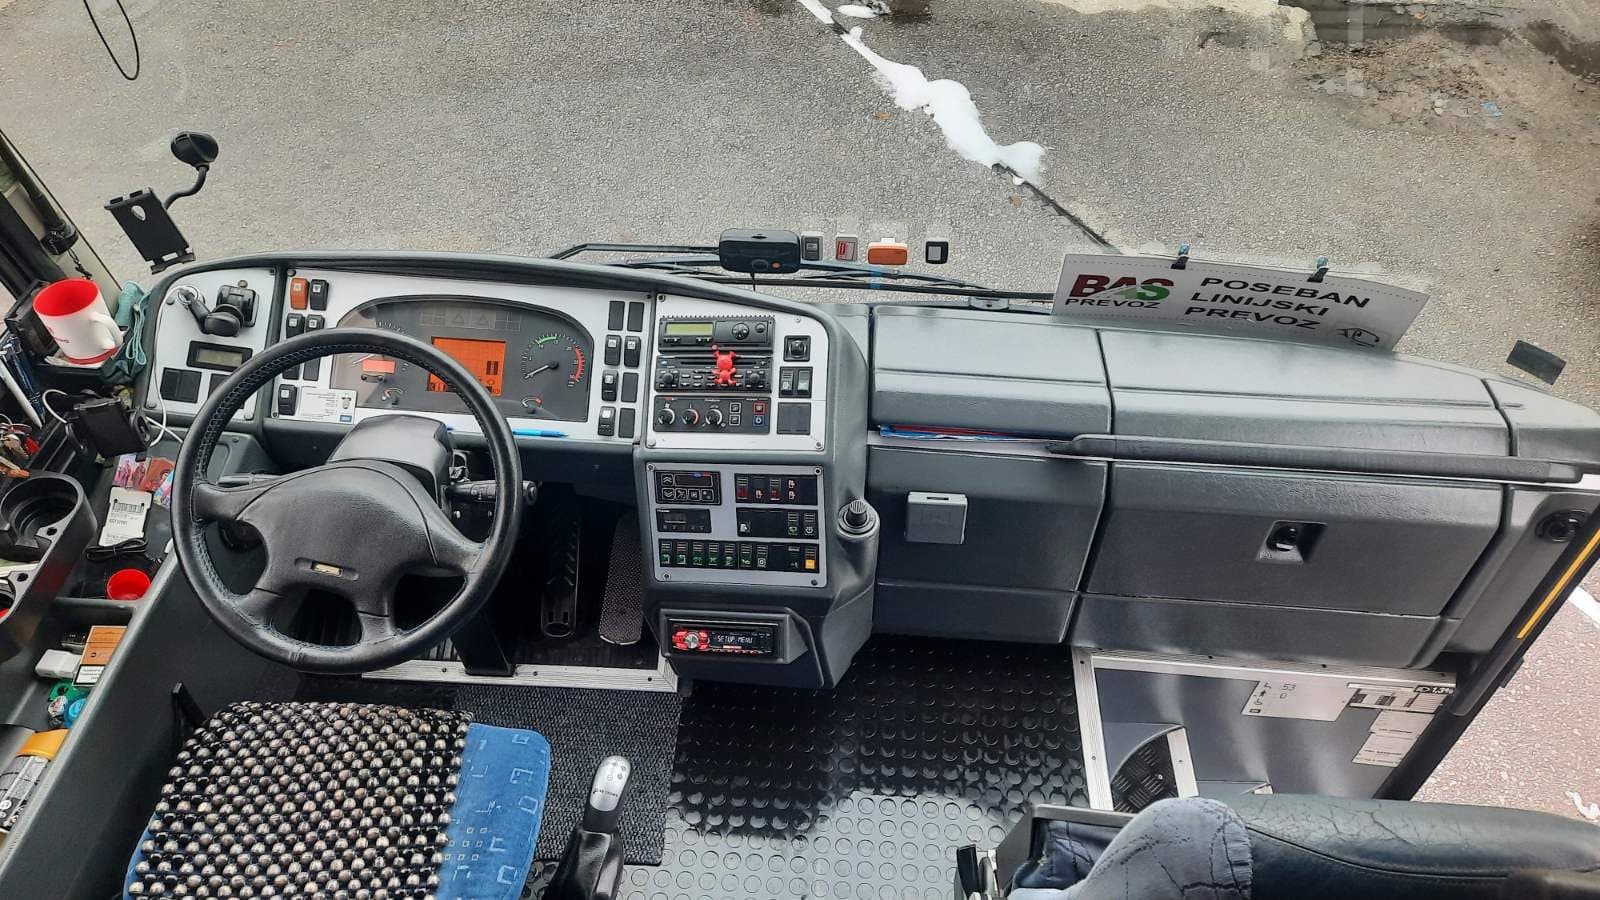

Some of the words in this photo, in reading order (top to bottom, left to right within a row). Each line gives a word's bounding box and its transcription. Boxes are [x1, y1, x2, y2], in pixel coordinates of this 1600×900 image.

[1069, 274, 1175, 301] BAS
[1200, 277, 1370, 308] POSEBAN
[1065, 298, 1161, 309] PREVOZ
[1191, 292, 1329, 316] LINIJSKI
[1184, 306, 1321, 330] PREVOZ
[717, 635, 736, 643] SETUP
